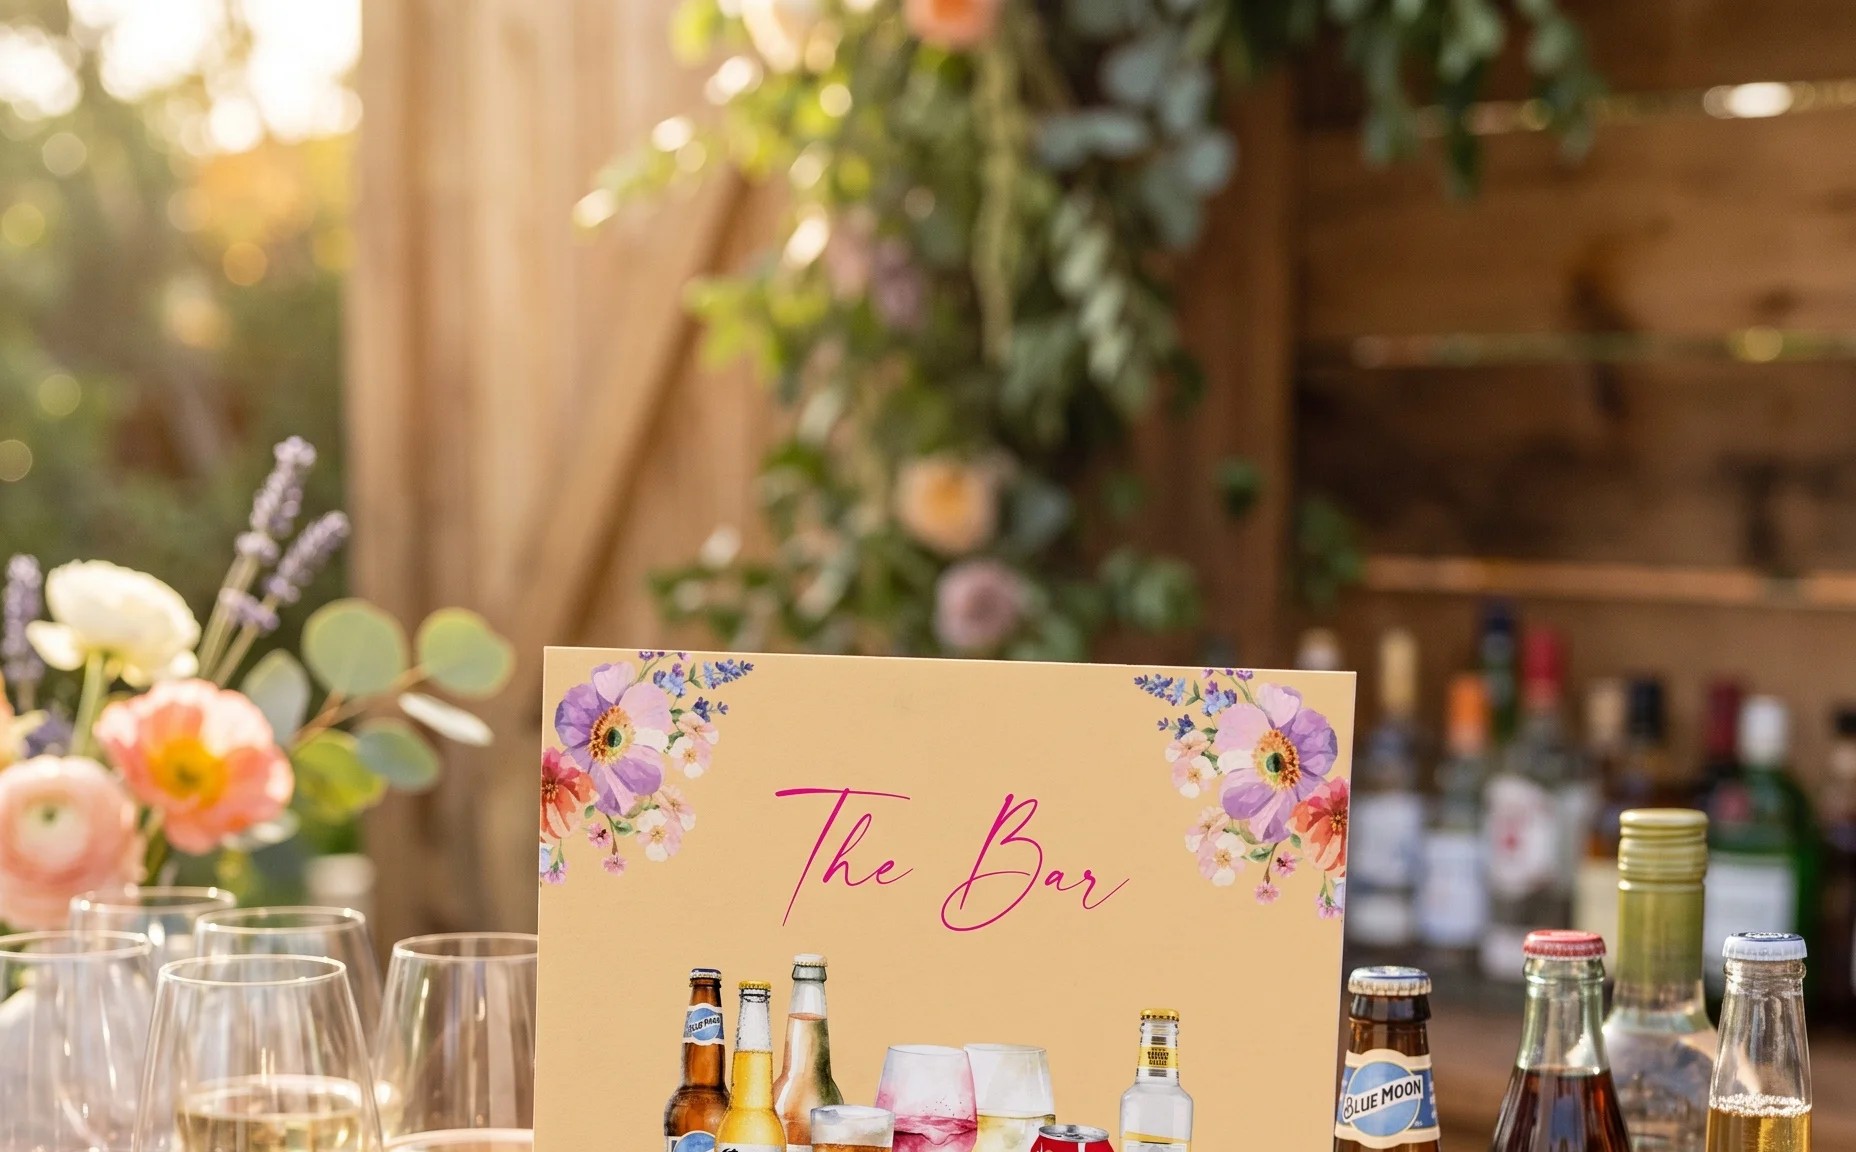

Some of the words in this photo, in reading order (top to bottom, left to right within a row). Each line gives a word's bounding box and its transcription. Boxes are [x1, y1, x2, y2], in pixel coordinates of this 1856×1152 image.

[775, 788, 913, 926] The
[941, 794, 1129, 931] Bar
[1343, 1093, 1378, 1120] BLUE
[1381, 1079, 1422, 1105] MOON
